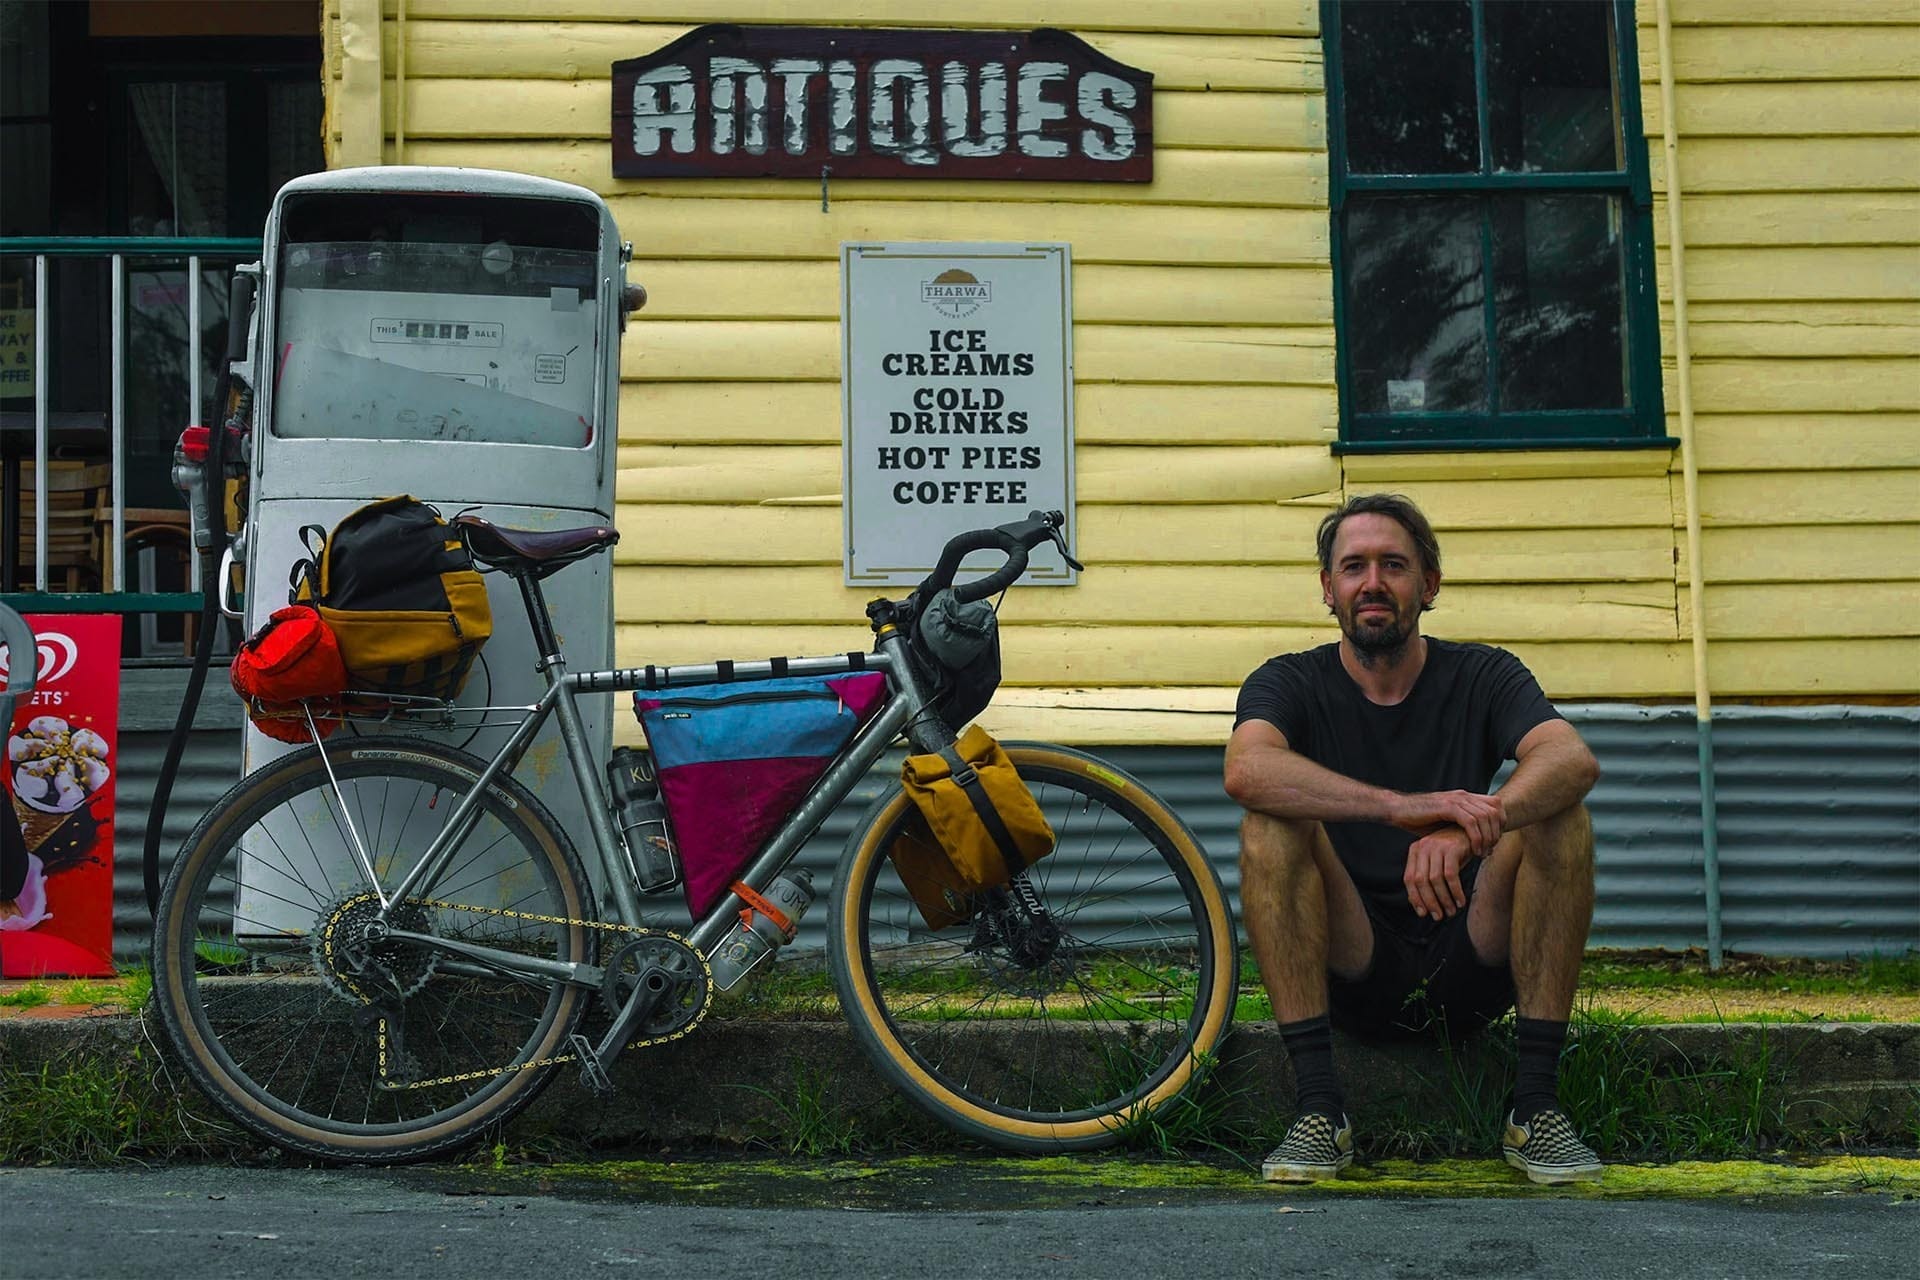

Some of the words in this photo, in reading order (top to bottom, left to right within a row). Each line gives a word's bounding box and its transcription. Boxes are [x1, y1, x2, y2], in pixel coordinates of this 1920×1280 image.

[632, 56, 1136, 165] ANTIQUES
[925, 286, 987, 297] THARWA
[376, 325, 398, 334] THIS
[474, 330, 498, 338] SALE
[929, 330, 987, 352] ICE
[0, 368, 31, 383] FFEE
[882, 353, 1035, 376] CREAMS
[913, 387, 1005, 411] COLD
[889, 411, 1029, 435] DRINKS
[878, 446, 950, 470] HOT
[962, 446, 1041, 470] PIES
[893, 481, 1027, 505] COFFEE
[612, 666, 672, 688] BET
[357, 750, 399, 760] Panaracer
[1012, 871, 1046, 916] Hunt
